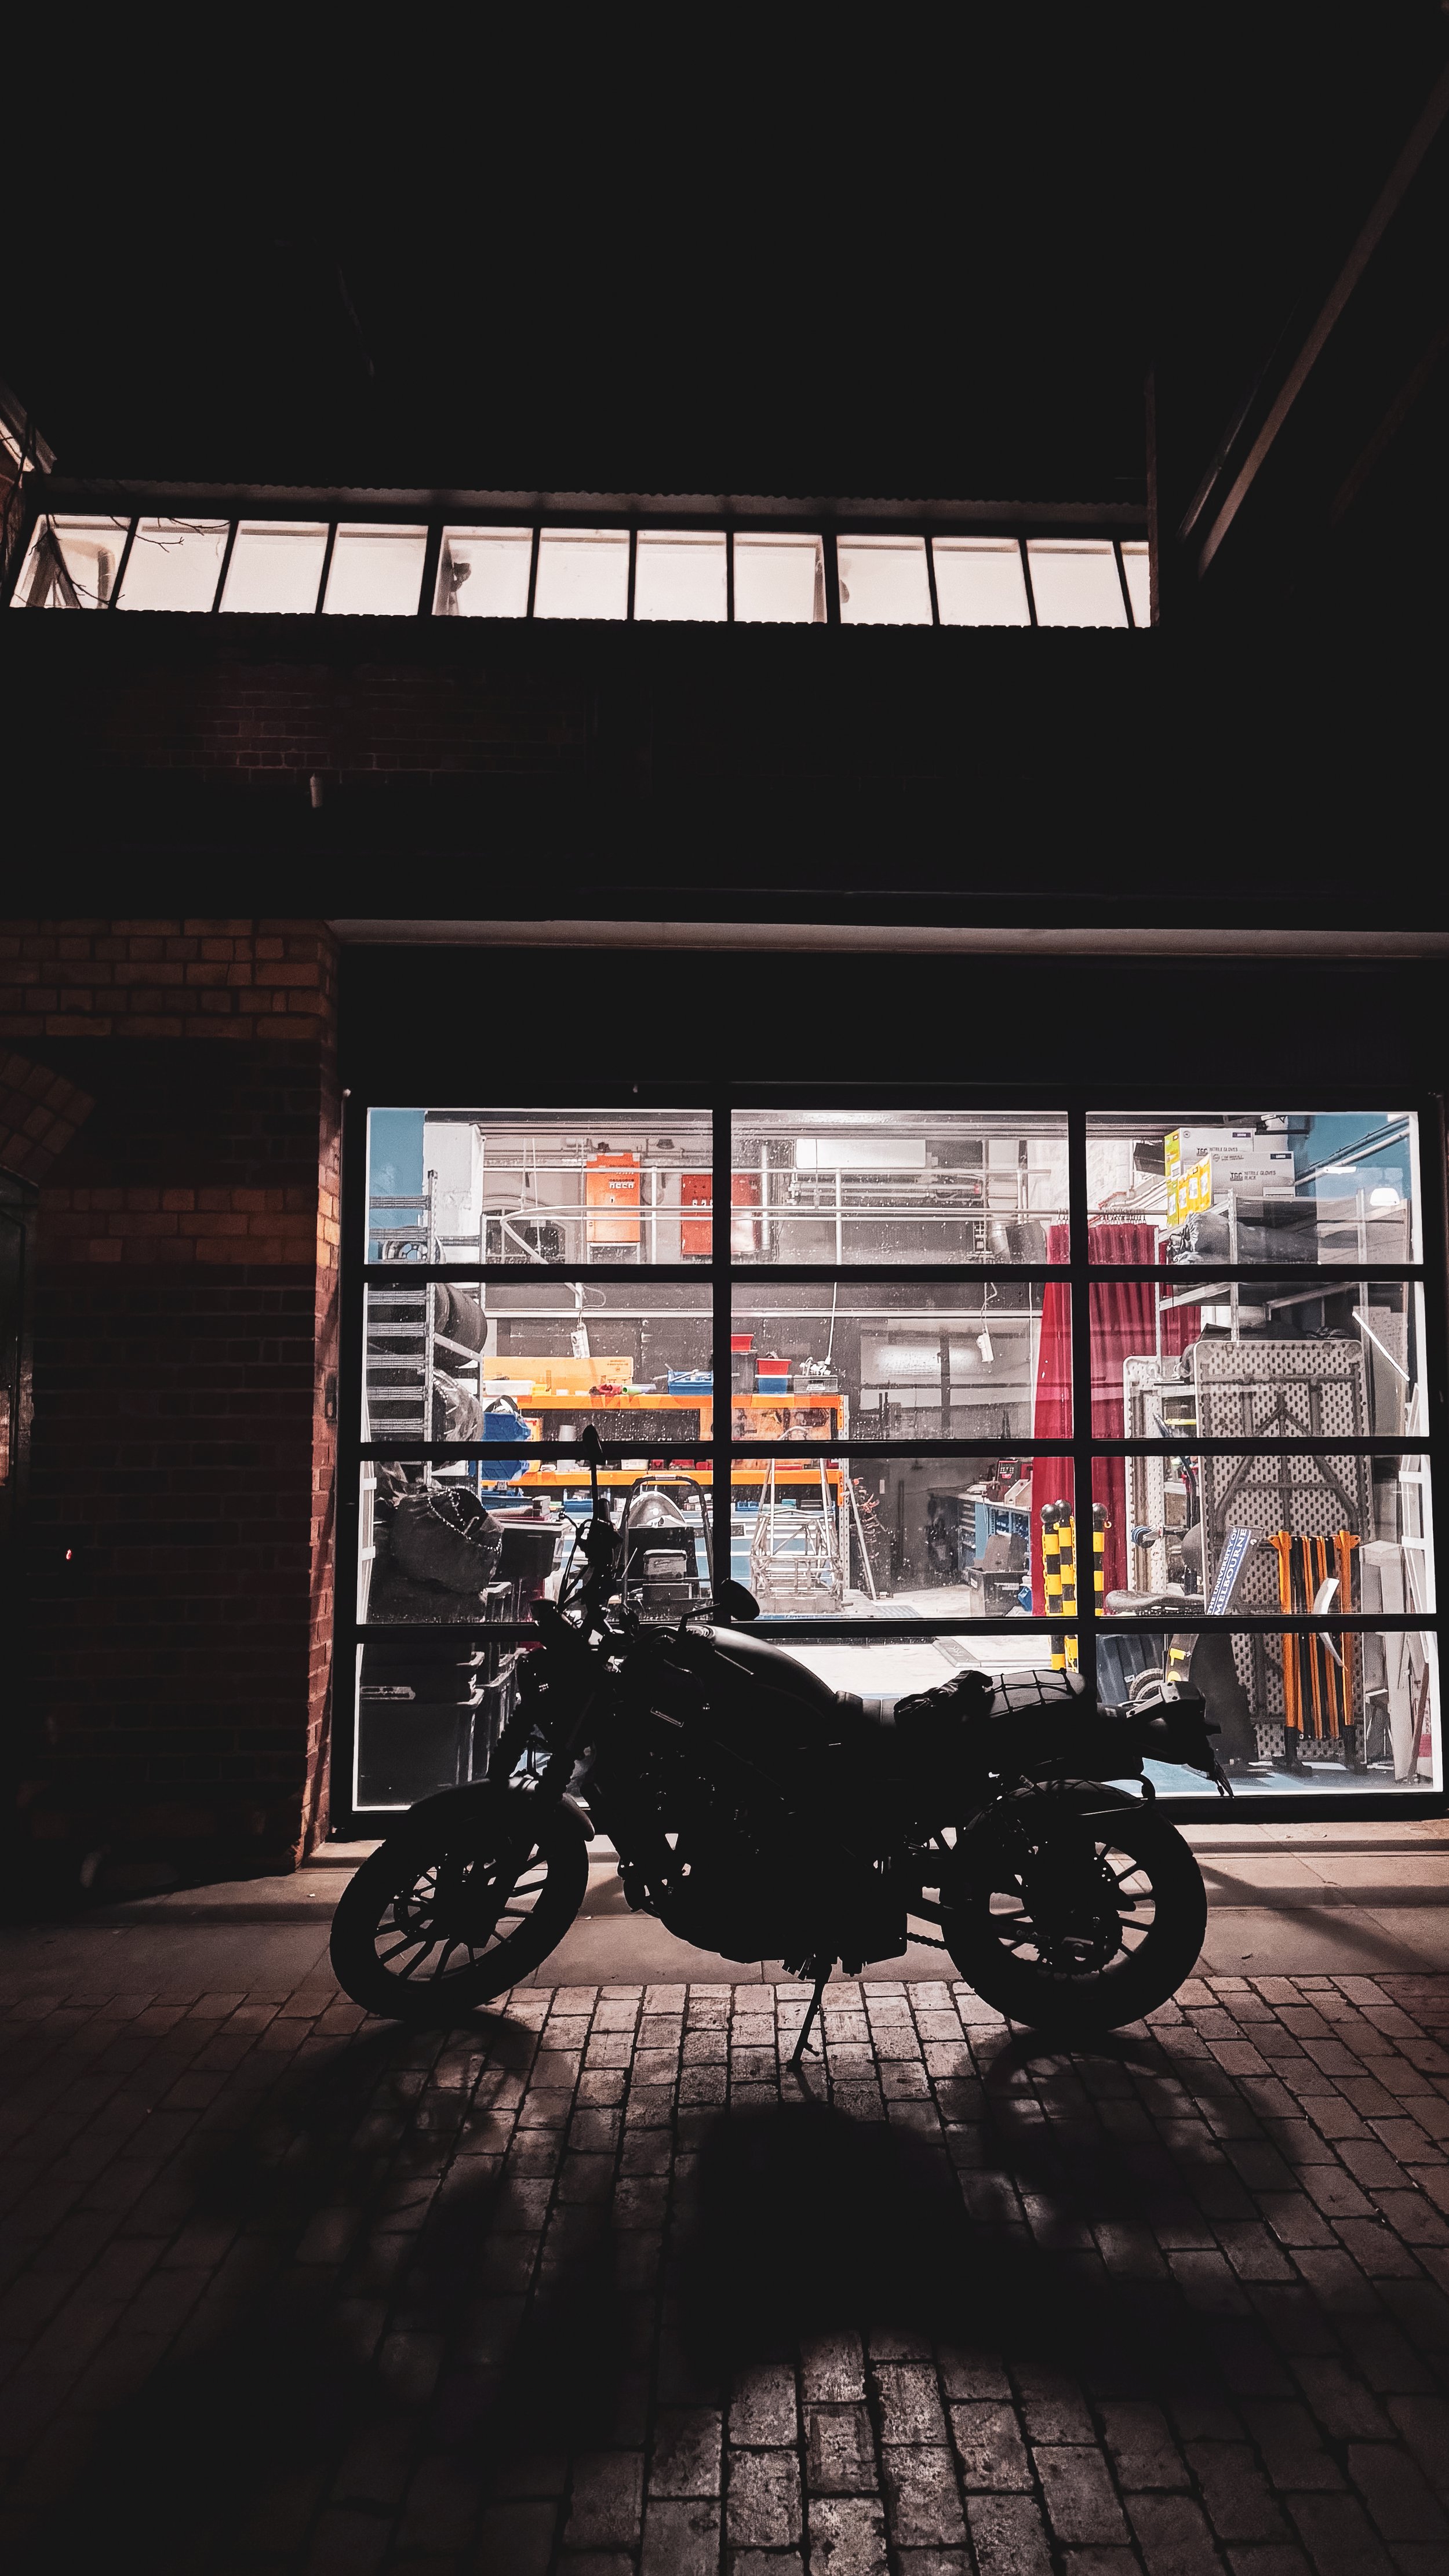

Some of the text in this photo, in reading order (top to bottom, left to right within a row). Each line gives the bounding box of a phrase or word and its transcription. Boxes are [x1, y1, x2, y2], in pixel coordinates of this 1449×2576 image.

[1207, 1595, 1216, 1615] THE
[1213, 1542, 1233, 1595] UNIVERSITY
[1214, 1528, 1247, 1616] MELBOURNE
